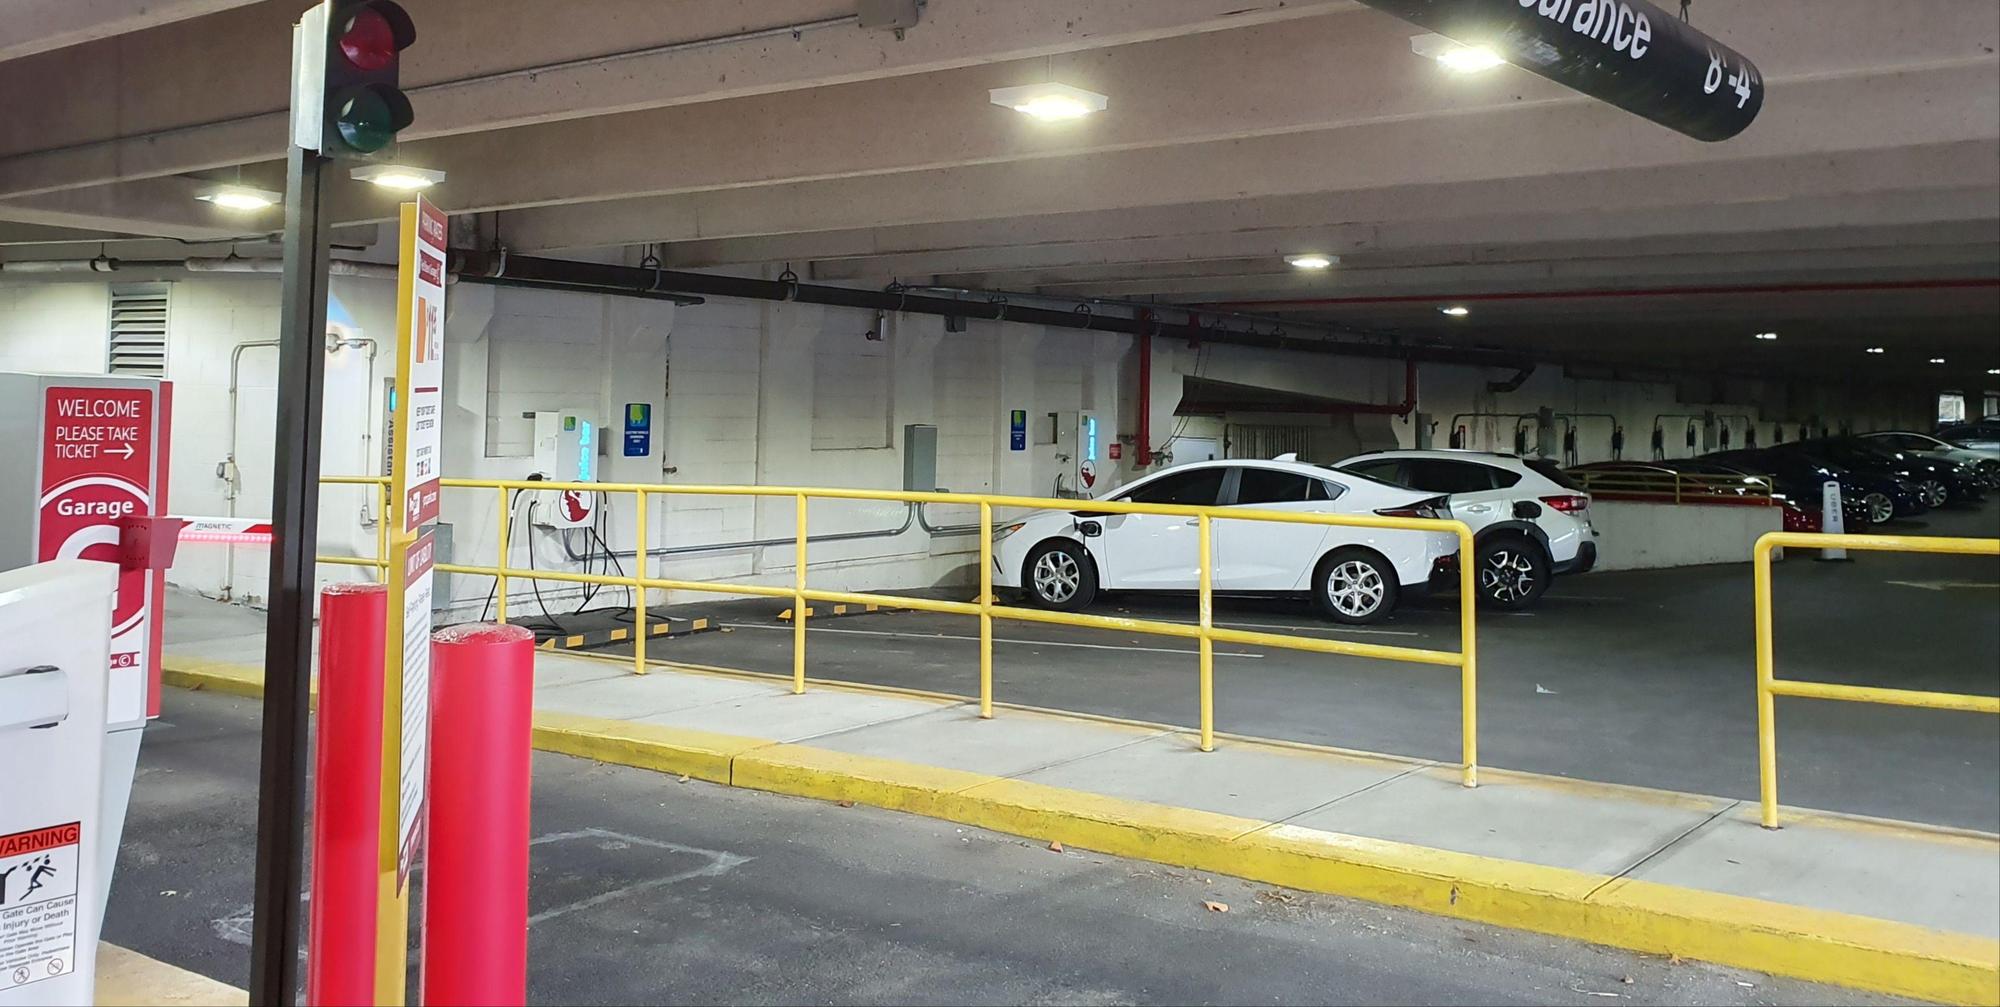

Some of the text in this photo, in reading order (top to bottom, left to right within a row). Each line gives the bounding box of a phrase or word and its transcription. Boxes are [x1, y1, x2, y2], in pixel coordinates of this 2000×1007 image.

[1518, 0, 1651, 59] arance
[57, 399, 141, 418] WELCOME
[55, 426, 138, 441] PLEASE TAKE
[55, 443, 99, 459] TICKET
[57, 498, 134, 519] Garage
[2, 898, 74, 920] Gate Can Cause
[3, 910, 70, 930] Injury or Death
